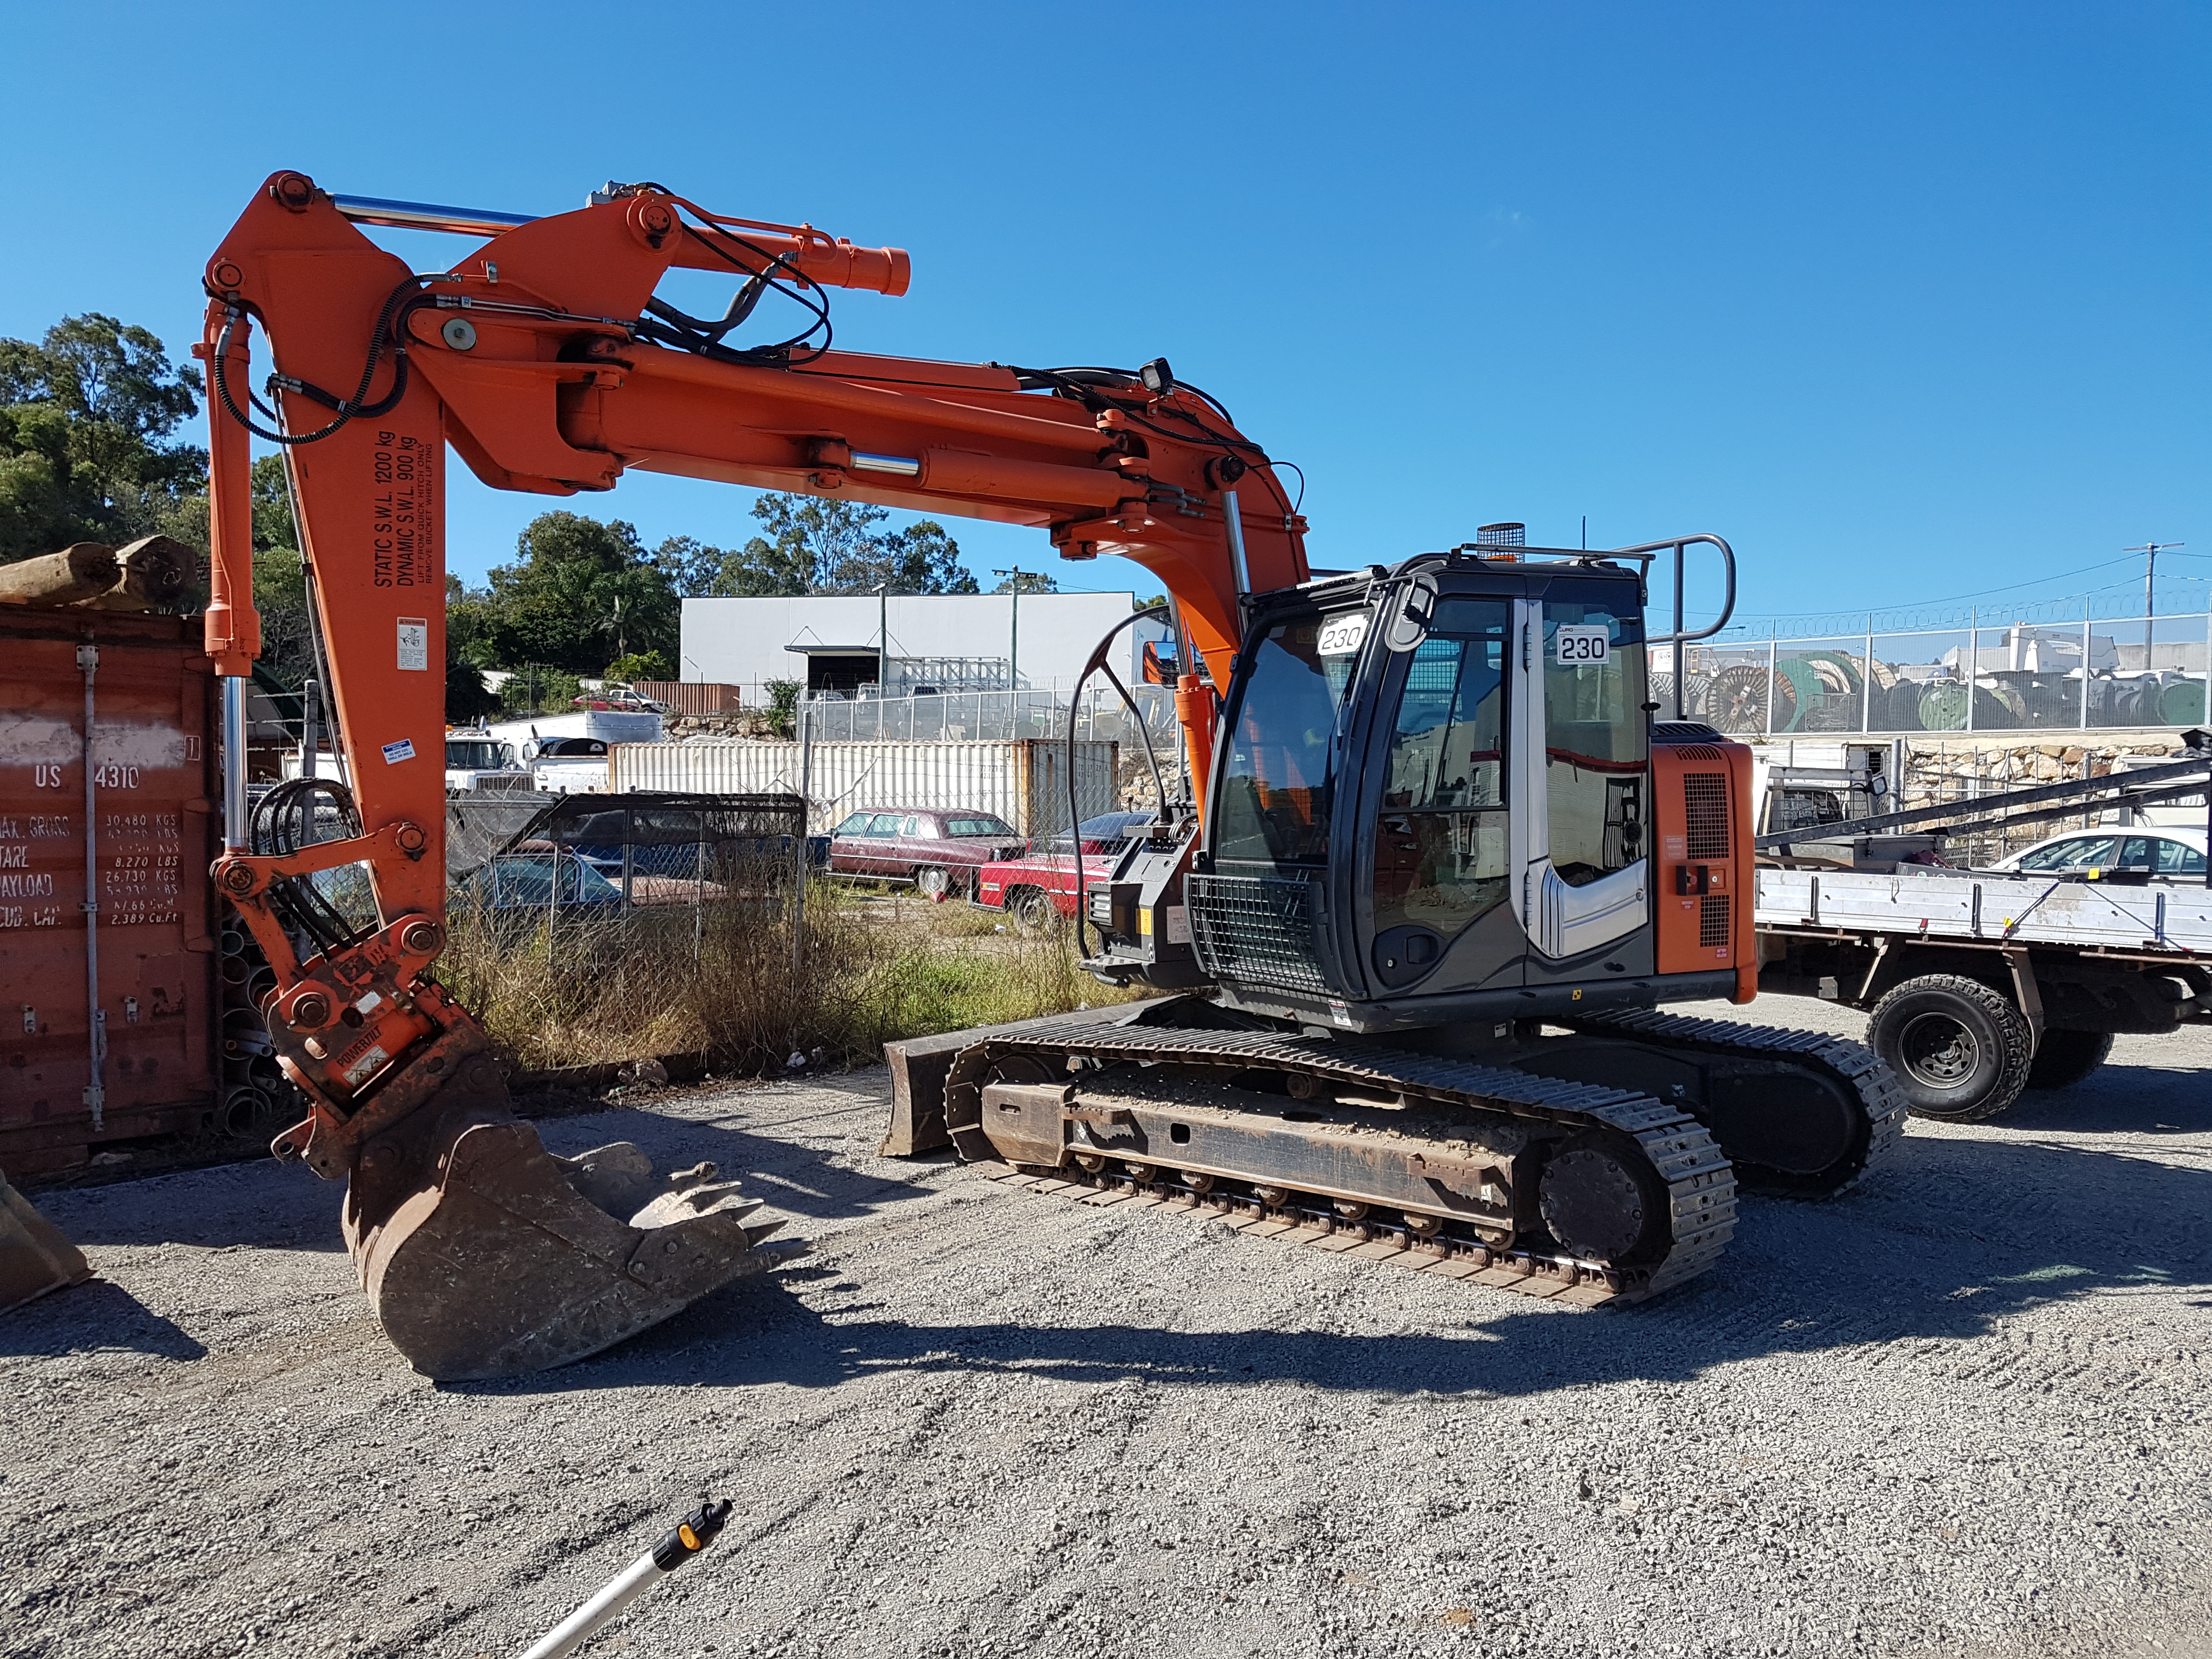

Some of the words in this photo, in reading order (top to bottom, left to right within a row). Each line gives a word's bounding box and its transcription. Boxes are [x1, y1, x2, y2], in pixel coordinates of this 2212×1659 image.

[375, 431, 396, 447] kg
[397, 437, 417, 451] kg
[374, 452, 392, 484] 1200
[397, 455, 414, 480] 900
[374, 492, 392, 533] S.W.L.
[396, 486, 414, 523] S.W.L.
[374, 539, 392, 588] STATIC
[396, 528, 414, 586] DYNAMIC
[1321, 627, 1361, 650] 230
[1562, 637, 1605, 659] 230
[36, 765, 61, 788] US
[94, 765, 139, 789] 4310
[156, 815, 176, 826] KGS
[115, 856, 148, 867] 8.270
[157, 856, 178, 867] LBS
[0, 874, 53, 897] AYLOAD
[106, 870, 146, 883] 26.730
[156, 870, 176, 882] KGS
[157, 884, 178, 895] BS
[111, 914, 145, 925] 2.389
[337, 1025, 382, 1067] POWERTILT
